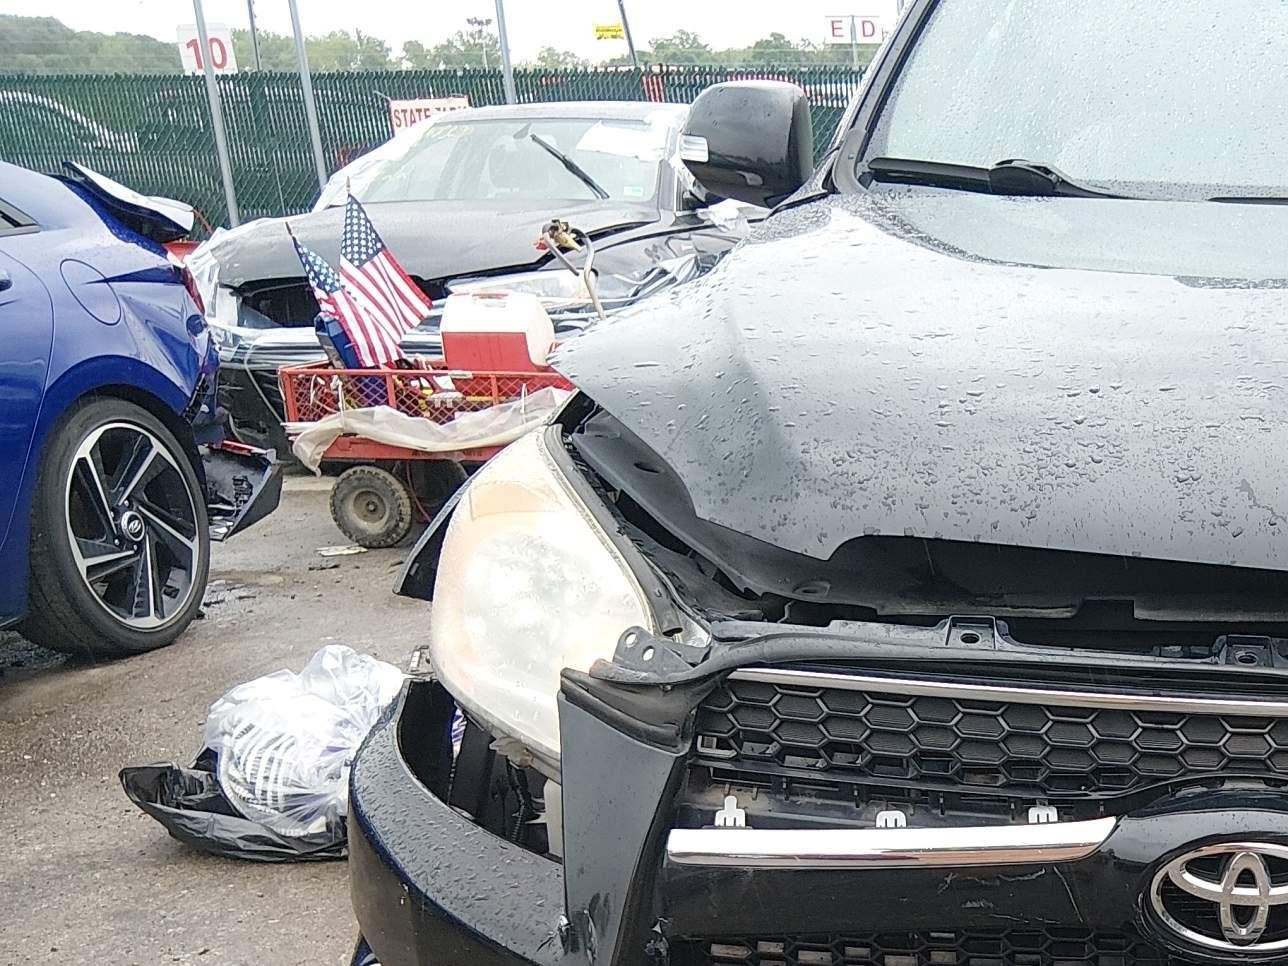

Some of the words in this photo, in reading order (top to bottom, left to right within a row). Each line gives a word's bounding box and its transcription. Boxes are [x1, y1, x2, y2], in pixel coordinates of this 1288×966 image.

[831, 20, 844, 37] E
[861, 20, 875, 37] D
[186, 37, 228, 69] 10
